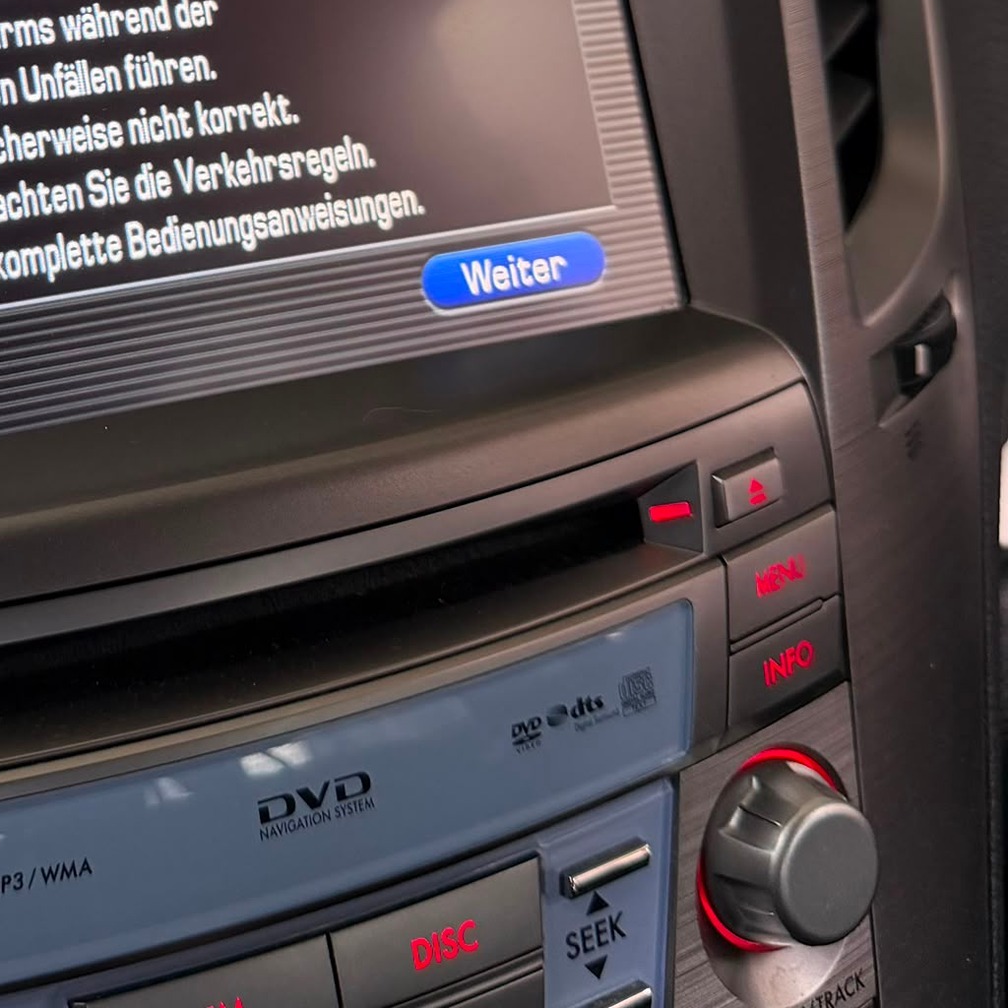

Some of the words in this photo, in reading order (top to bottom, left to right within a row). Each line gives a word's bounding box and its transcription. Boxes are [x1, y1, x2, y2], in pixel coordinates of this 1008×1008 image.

[19, 57, 121, 104] Unfällen
[124, 50, 218, 92] führen.
[127, 104, 194, 146] nicht
[195, 91, 300, 137] korrekt.
[85, 168, 131, 209] Sie
[134, 162, 173, 201] die
[174, 135, 377, 194] Verkehrsregeln.
[125, 188, 426, 261] Bedienungsanweisungen.
[460, 252, 568, 296] Weiter
[755, 553, 807, 598] MENU
[762, 639, 815, 687] INFO
[511, 715, 542, 739] DVD
[569, 694, 605, 719] dts
[257, 770, 372, 824] DVD
[259, 808, 332, 842] NAVIGATION
[335, 796, 376, 820] SYSTEM
[41, 857, 93, 884] WMA
[410, 918, 480, 971] DISC
[565, 910, 627, 960] SEEK
